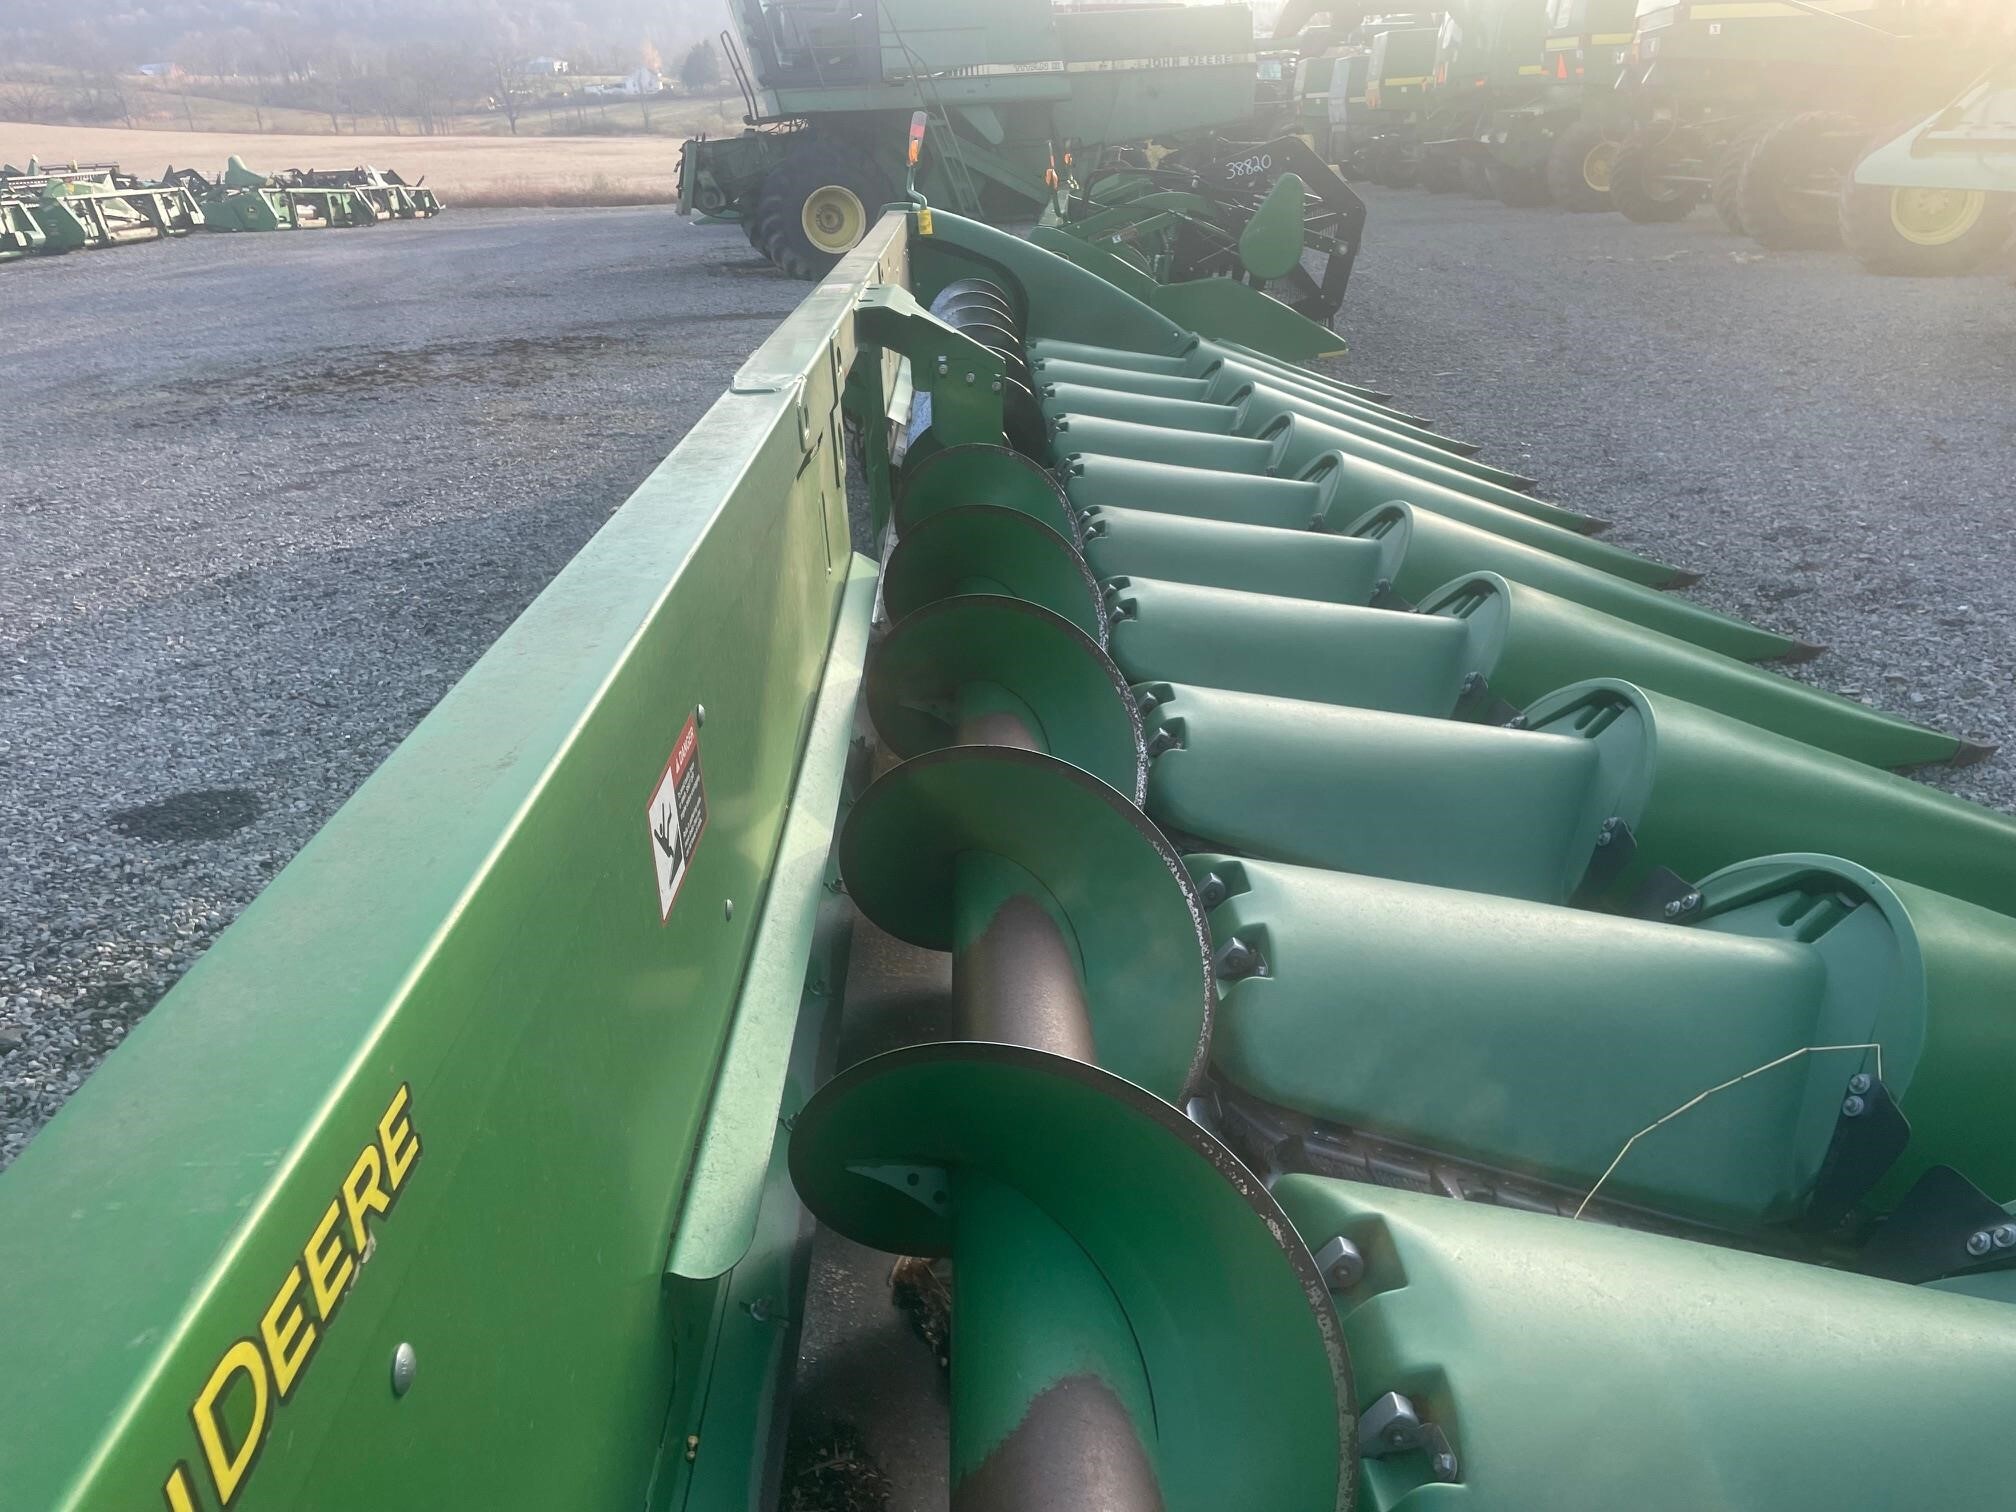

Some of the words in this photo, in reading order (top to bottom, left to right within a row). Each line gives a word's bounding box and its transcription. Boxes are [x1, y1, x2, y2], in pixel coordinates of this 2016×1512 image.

[1189, 55, 1232, 66] DEERE
[1226, 154, 1271, 180] 38820
[678, 725, 694, 766] DANGER
[192, 1083, 421, 1506] DEERE
